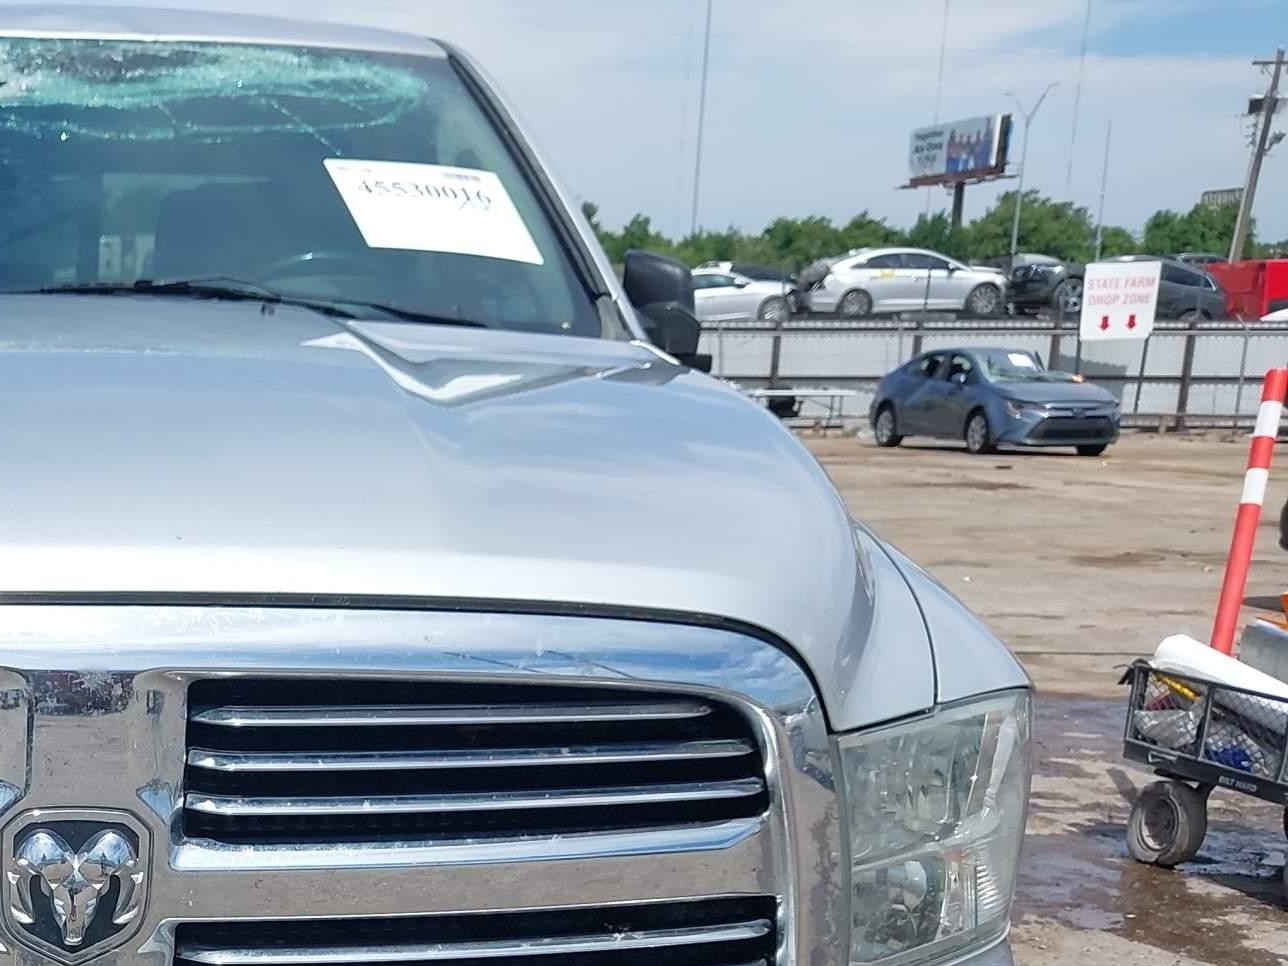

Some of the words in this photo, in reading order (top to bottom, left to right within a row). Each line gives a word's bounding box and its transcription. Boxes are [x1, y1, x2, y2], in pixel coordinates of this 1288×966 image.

[359, 179, 492, 207] 45530016
[1087, 277, 1121, 289] STATE
[1124, 276, 1156, 288] FARM
[1088, 293, 1120, 306] DROP
[1122, 292, 1151, 305] ZONE
